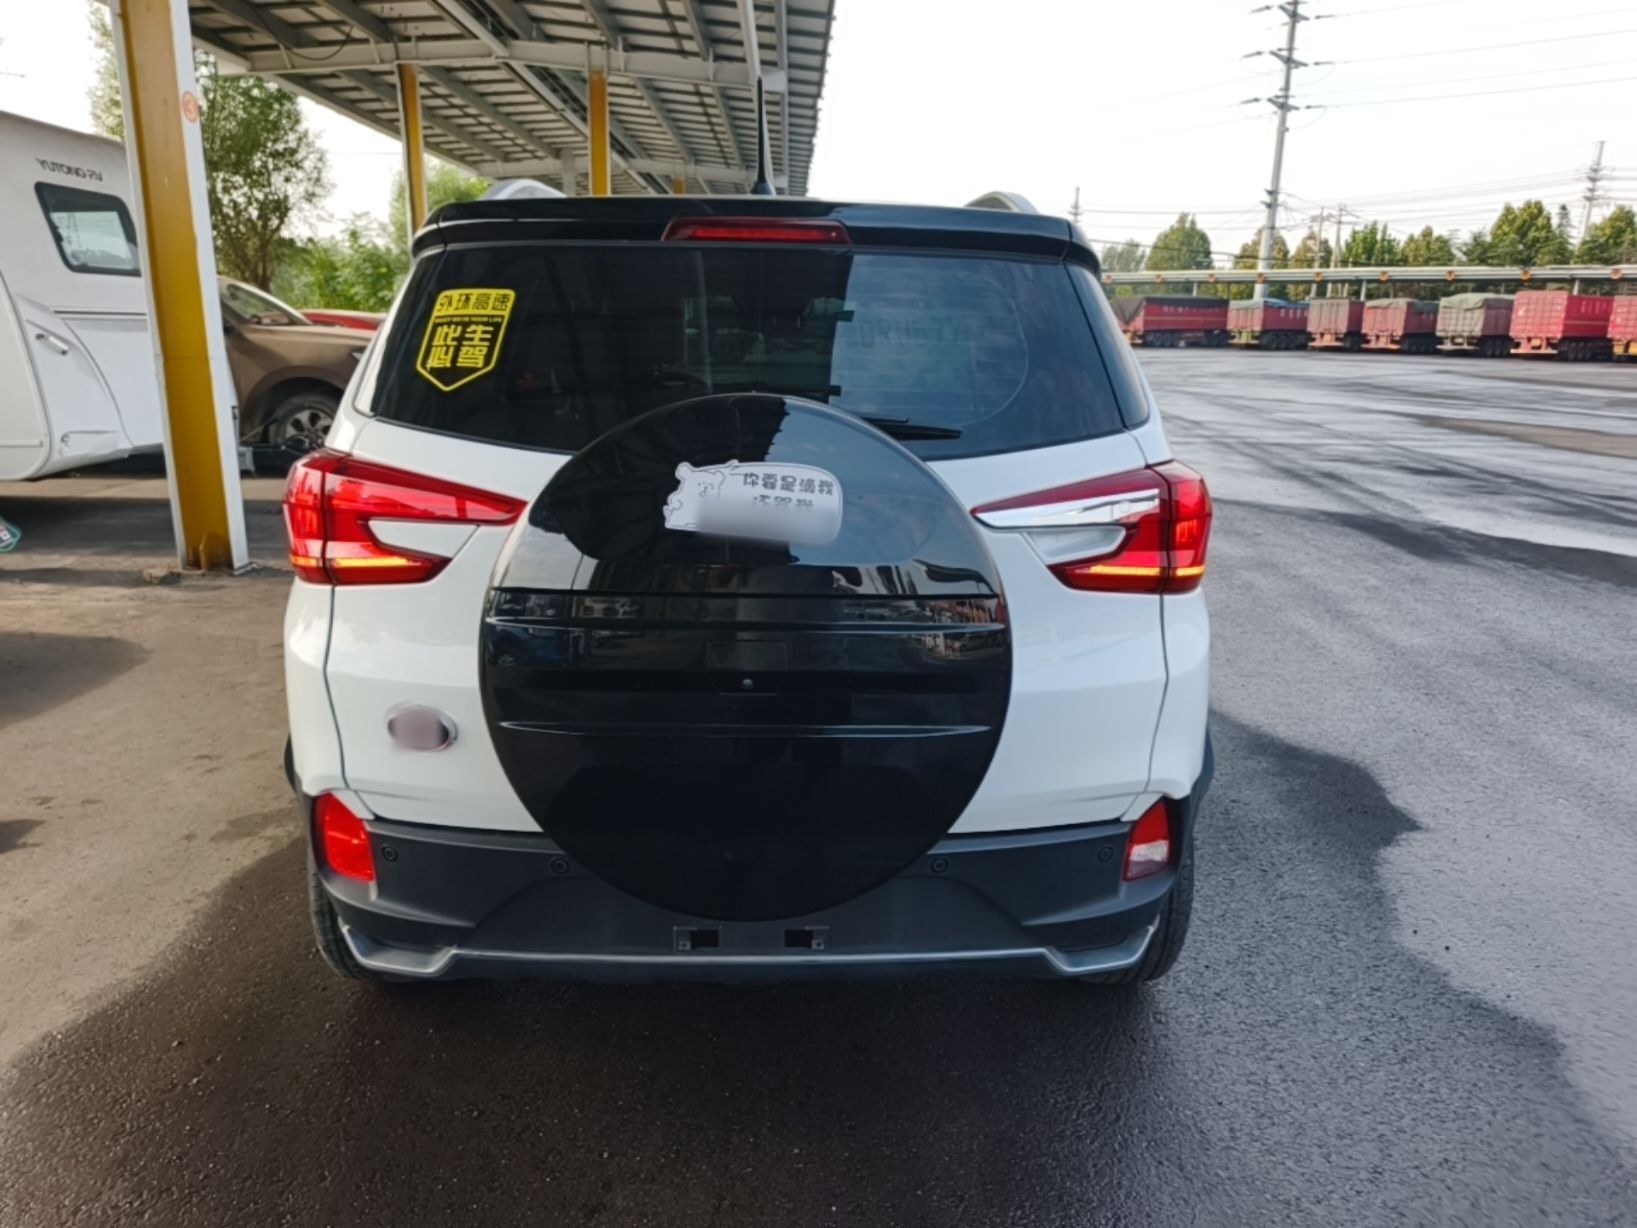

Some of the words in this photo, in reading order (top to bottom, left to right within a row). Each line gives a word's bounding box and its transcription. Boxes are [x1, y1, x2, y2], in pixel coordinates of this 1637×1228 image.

[436, 293, 512, 313] 外环高速
[431, 324, 495, 346] 此生
[426, 346, 489, 370] 必驾
